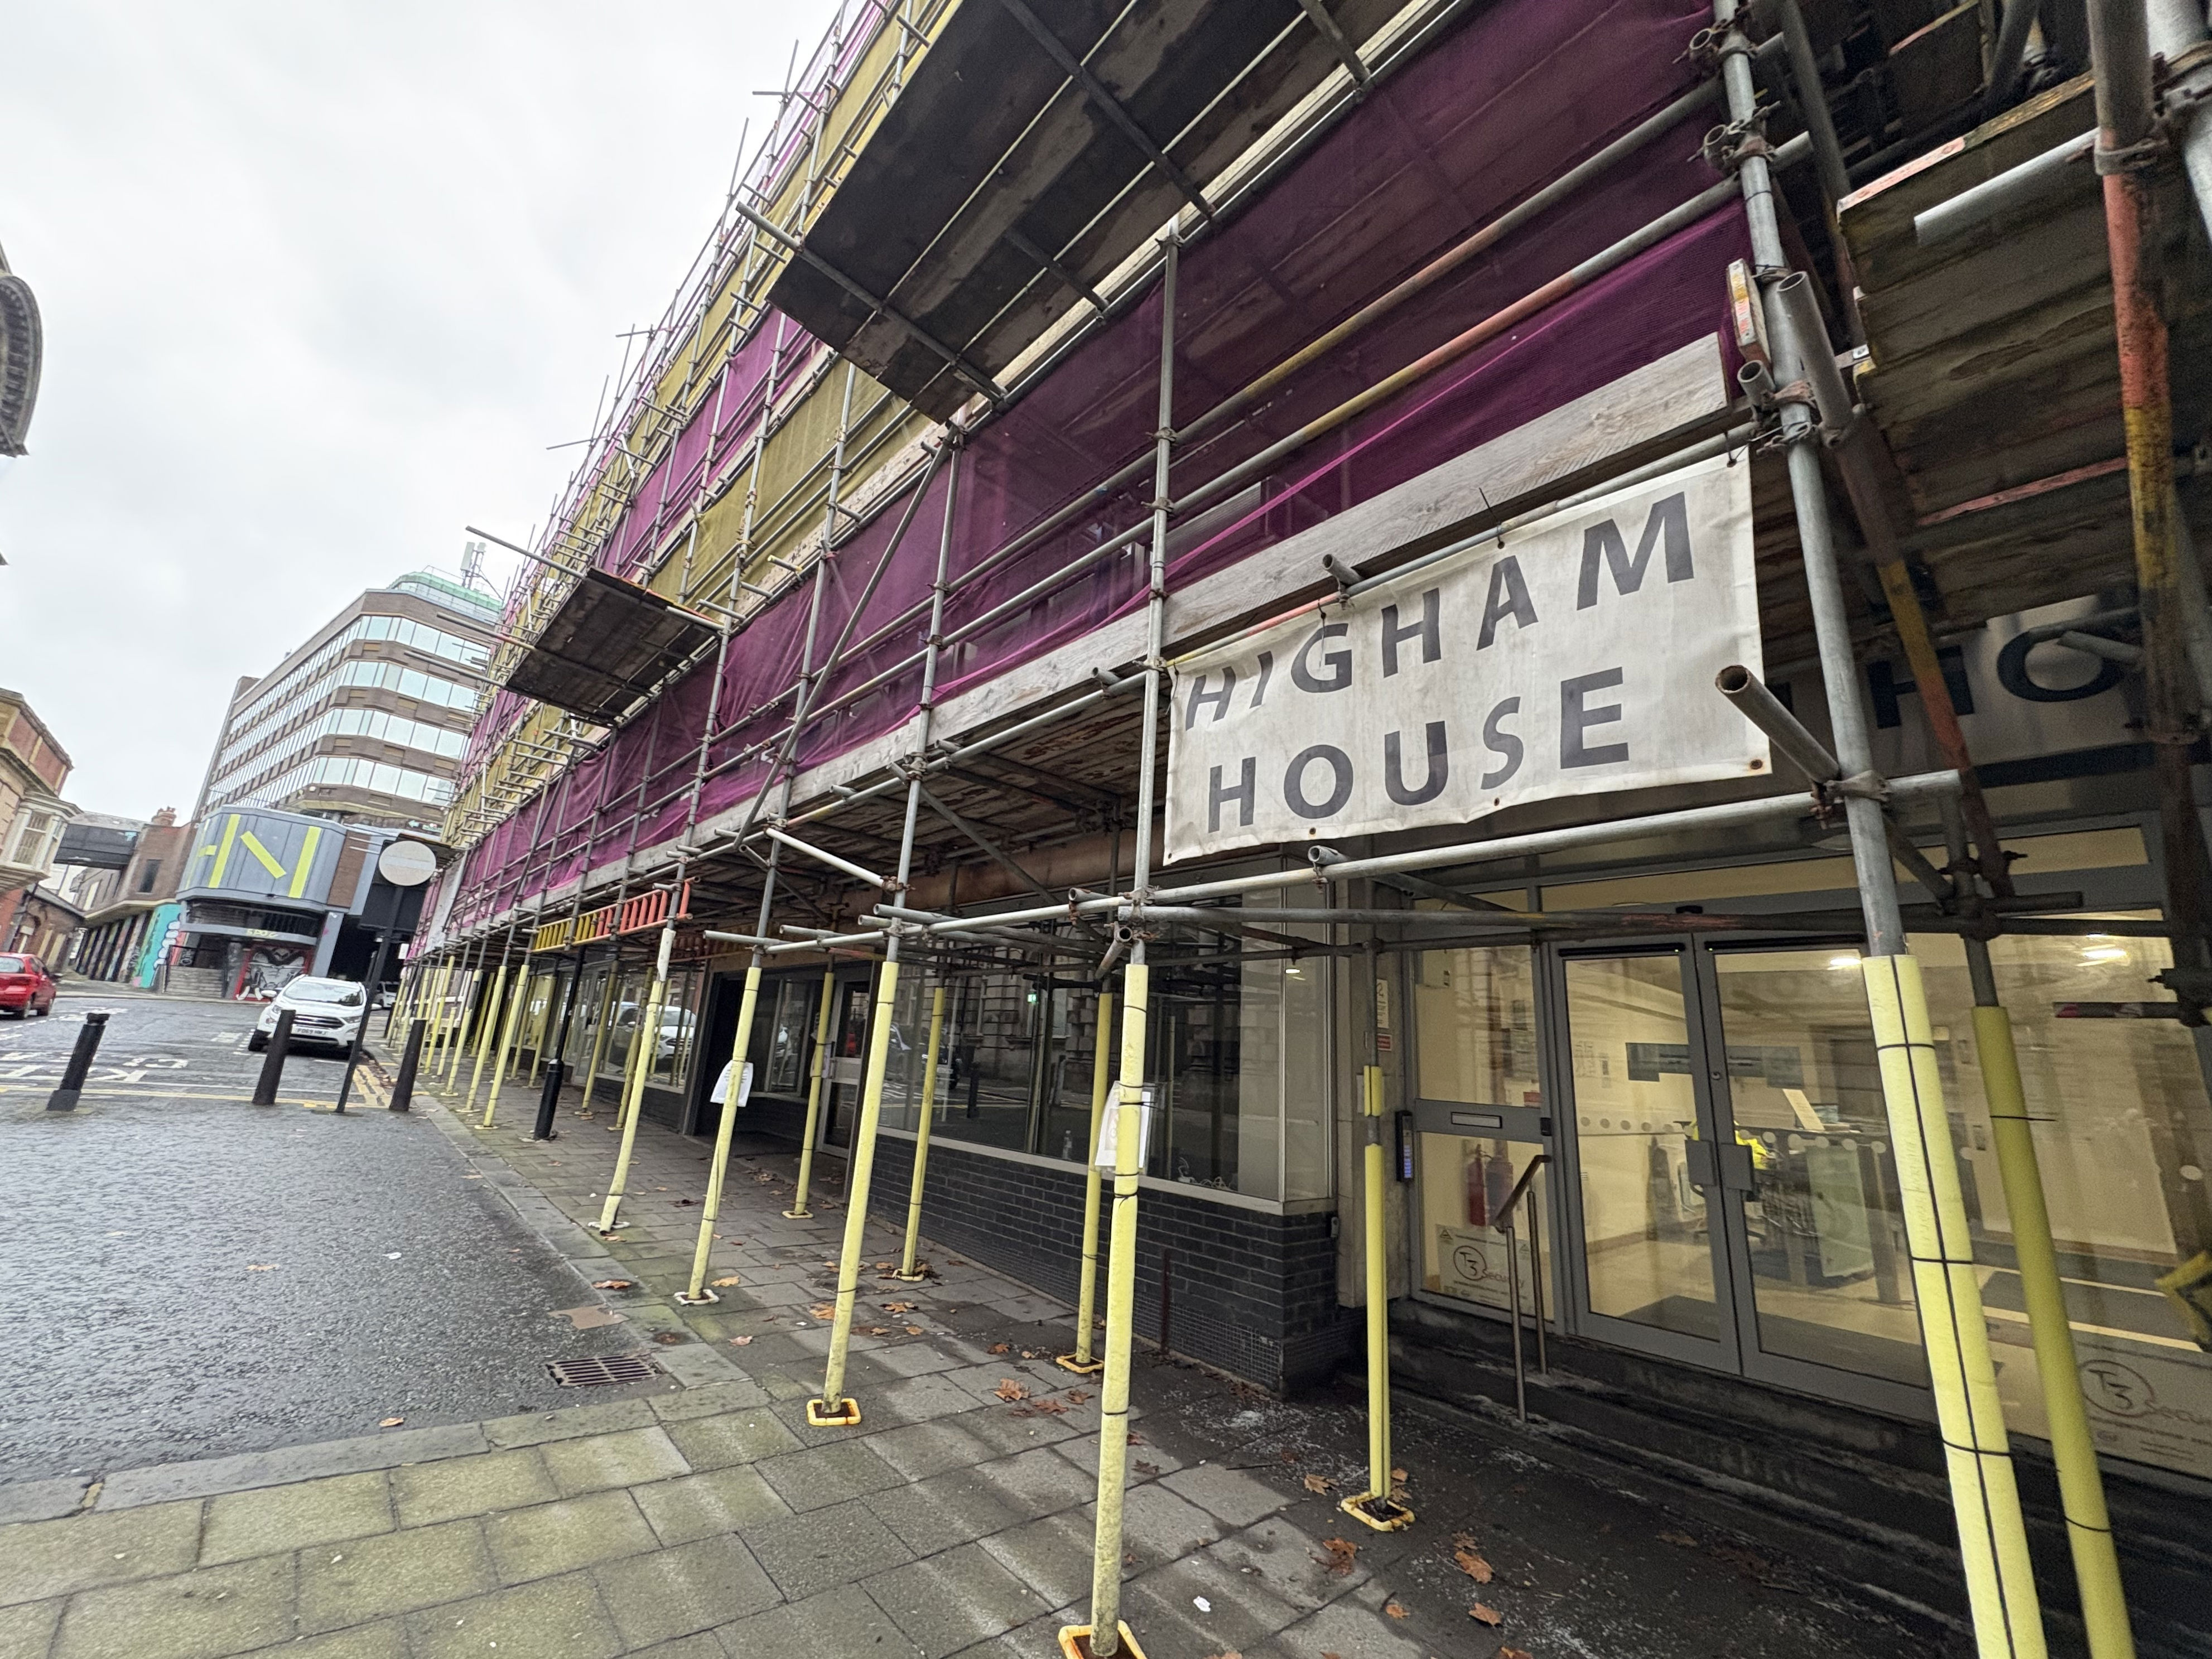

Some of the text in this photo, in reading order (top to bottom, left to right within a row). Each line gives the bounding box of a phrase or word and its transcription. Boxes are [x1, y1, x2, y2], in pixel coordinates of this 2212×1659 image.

[1185, 491, 1694, 731] HIGHAM
[1208, 667, 1629, 833] HOUSE
[1459, 1251, 1478, 1276] T3
[2088, 1368, 2133, 1410] T3
